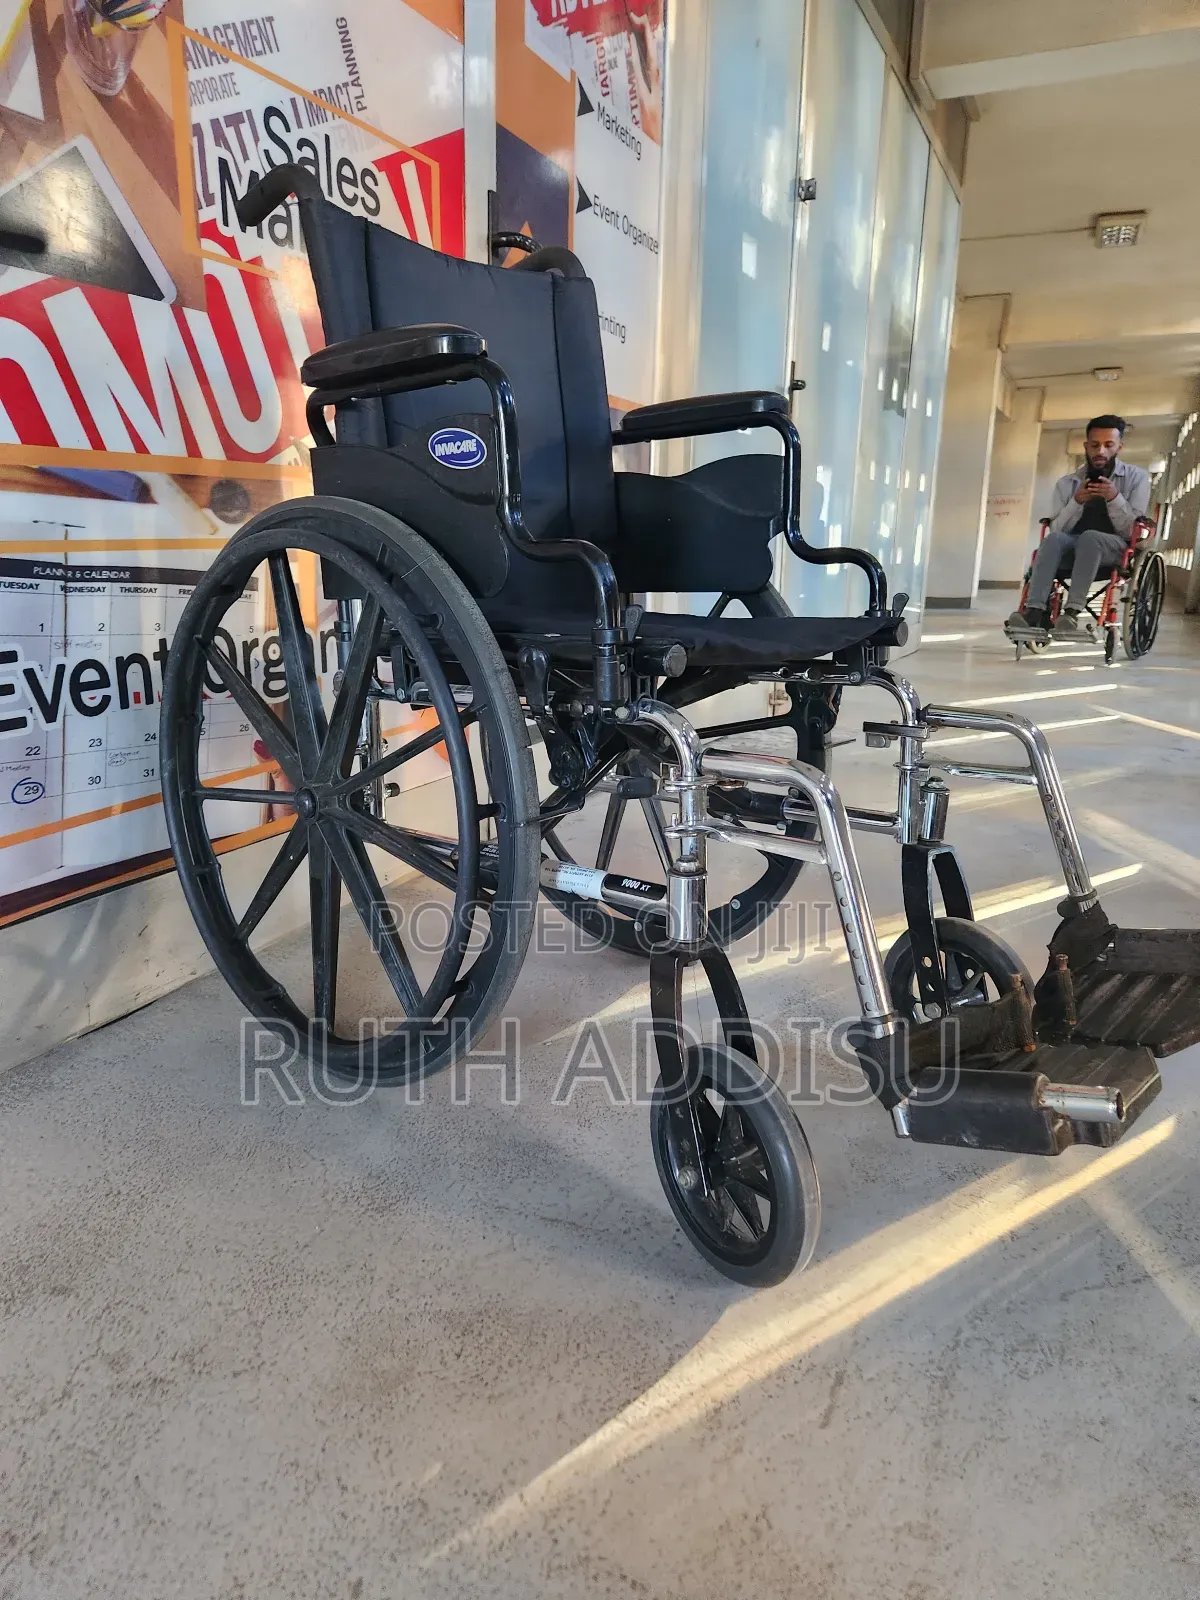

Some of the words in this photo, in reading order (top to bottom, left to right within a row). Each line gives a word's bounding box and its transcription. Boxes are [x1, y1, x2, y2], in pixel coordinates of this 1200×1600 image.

[335, 16, 368, 112] PLANNING
[302, 82, 355, 127] IMPACT
[597, 101, 642, 161] Marketing
[263, 105, 381, 217] Sales
[593, 194, 620, 230] Event
[622, 214, 660, 255] Organize
[434, 438, 477, 457] INVACARE
[33, 566, 72, 579] PLANNR
[75, 571, 81, 579] &
[83, 570, 131, 579] CALENDAR
[119, 586, 158, 594] THURSDAY
[38, 622, 45, 632] 1
[98, 622, 105, 632] 2
[154, 622, 161, 632] 3
[249, 625, 254, 634] 5
[239, 724, 250, 733] 26
[25, 745, 41, 757] 22
[88, 738, 103, 748] 23
[144, 732, 157, 742] 24
[24, 785, 40, 796] 29
[88, 775, 102, 786] 30
[143, 768, 155, 777] 31
[621, 878, 640, 890] 9000
[640, 883, 652, 892] XT
